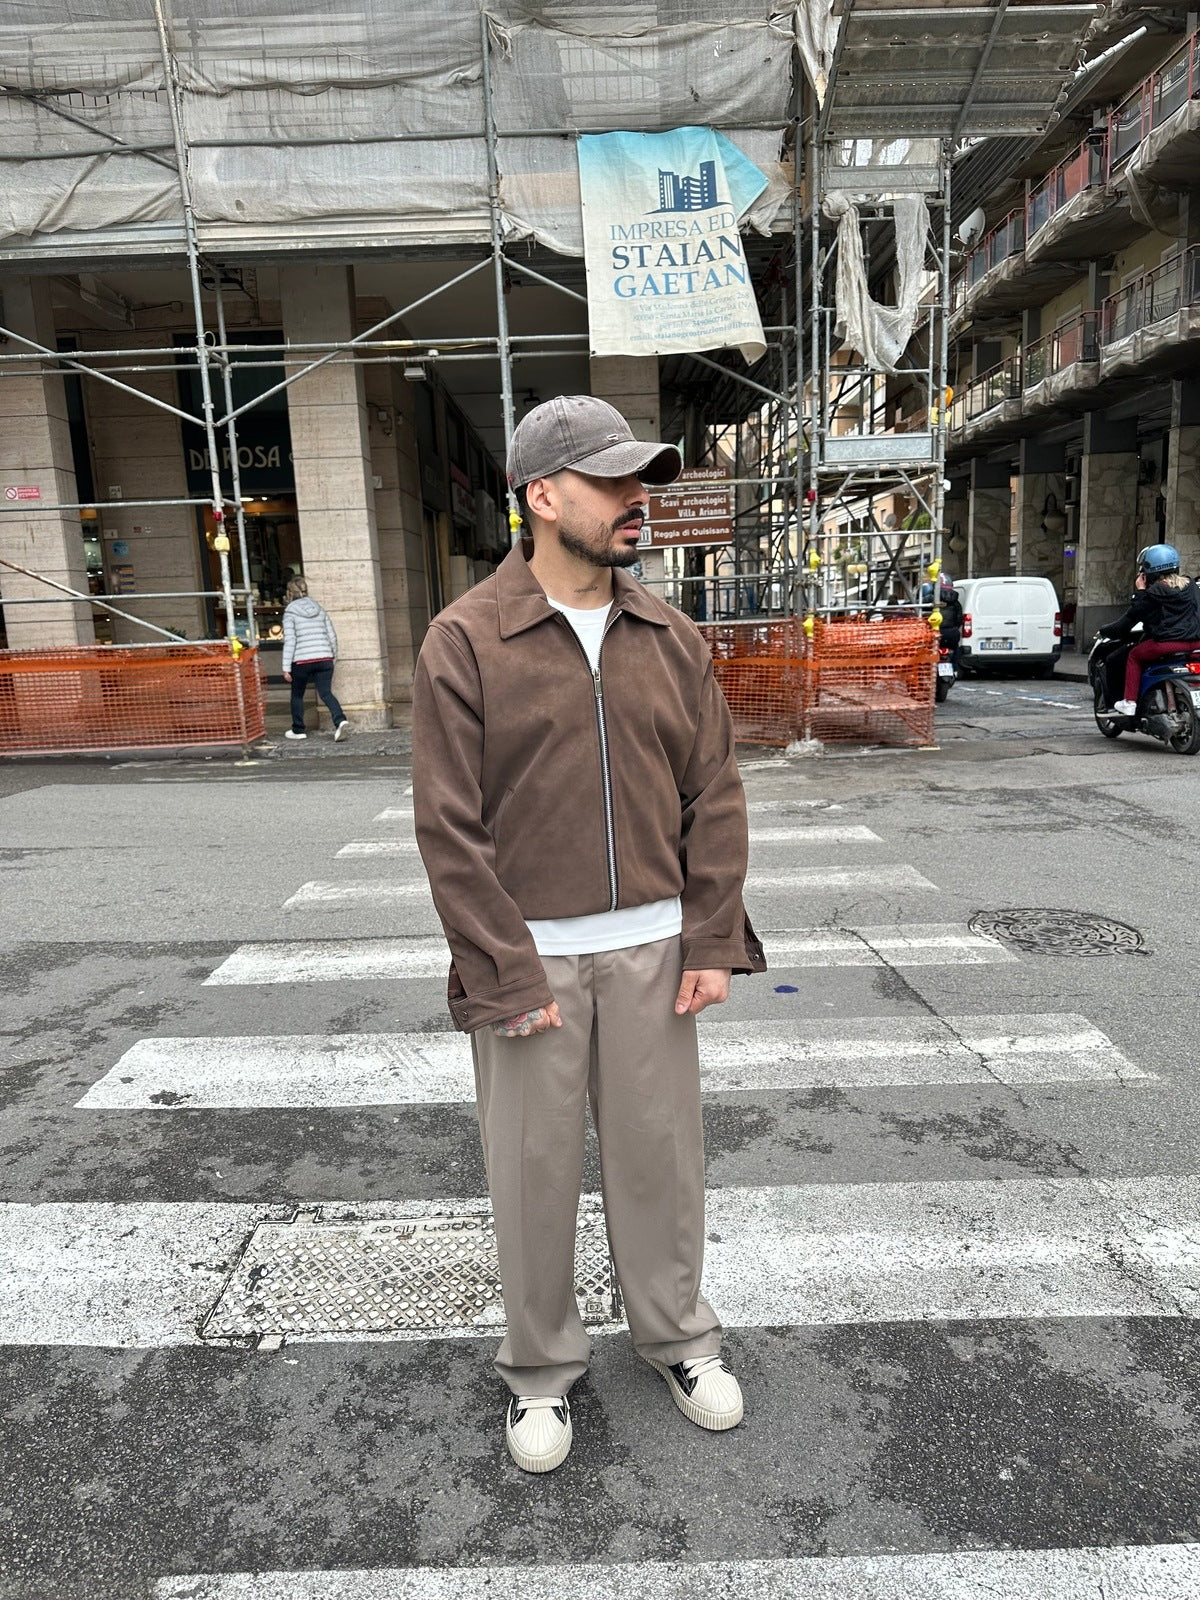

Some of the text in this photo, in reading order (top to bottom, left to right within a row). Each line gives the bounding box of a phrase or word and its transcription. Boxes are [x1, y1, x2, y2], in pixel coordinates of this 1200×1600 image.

[610, 212, 736, 241] IMPRESA ED
[612, 234, 742, 270] STAIAN
[613, 262, 746, 298] GAETAN
[682, 468, 726, 480] archeologici
[660, 496, 726, 508] Scavi archeologici
[678, 507, 727, 518] Villa Arianna
[653, 527, 730, 539] Reggia di Quisisana
